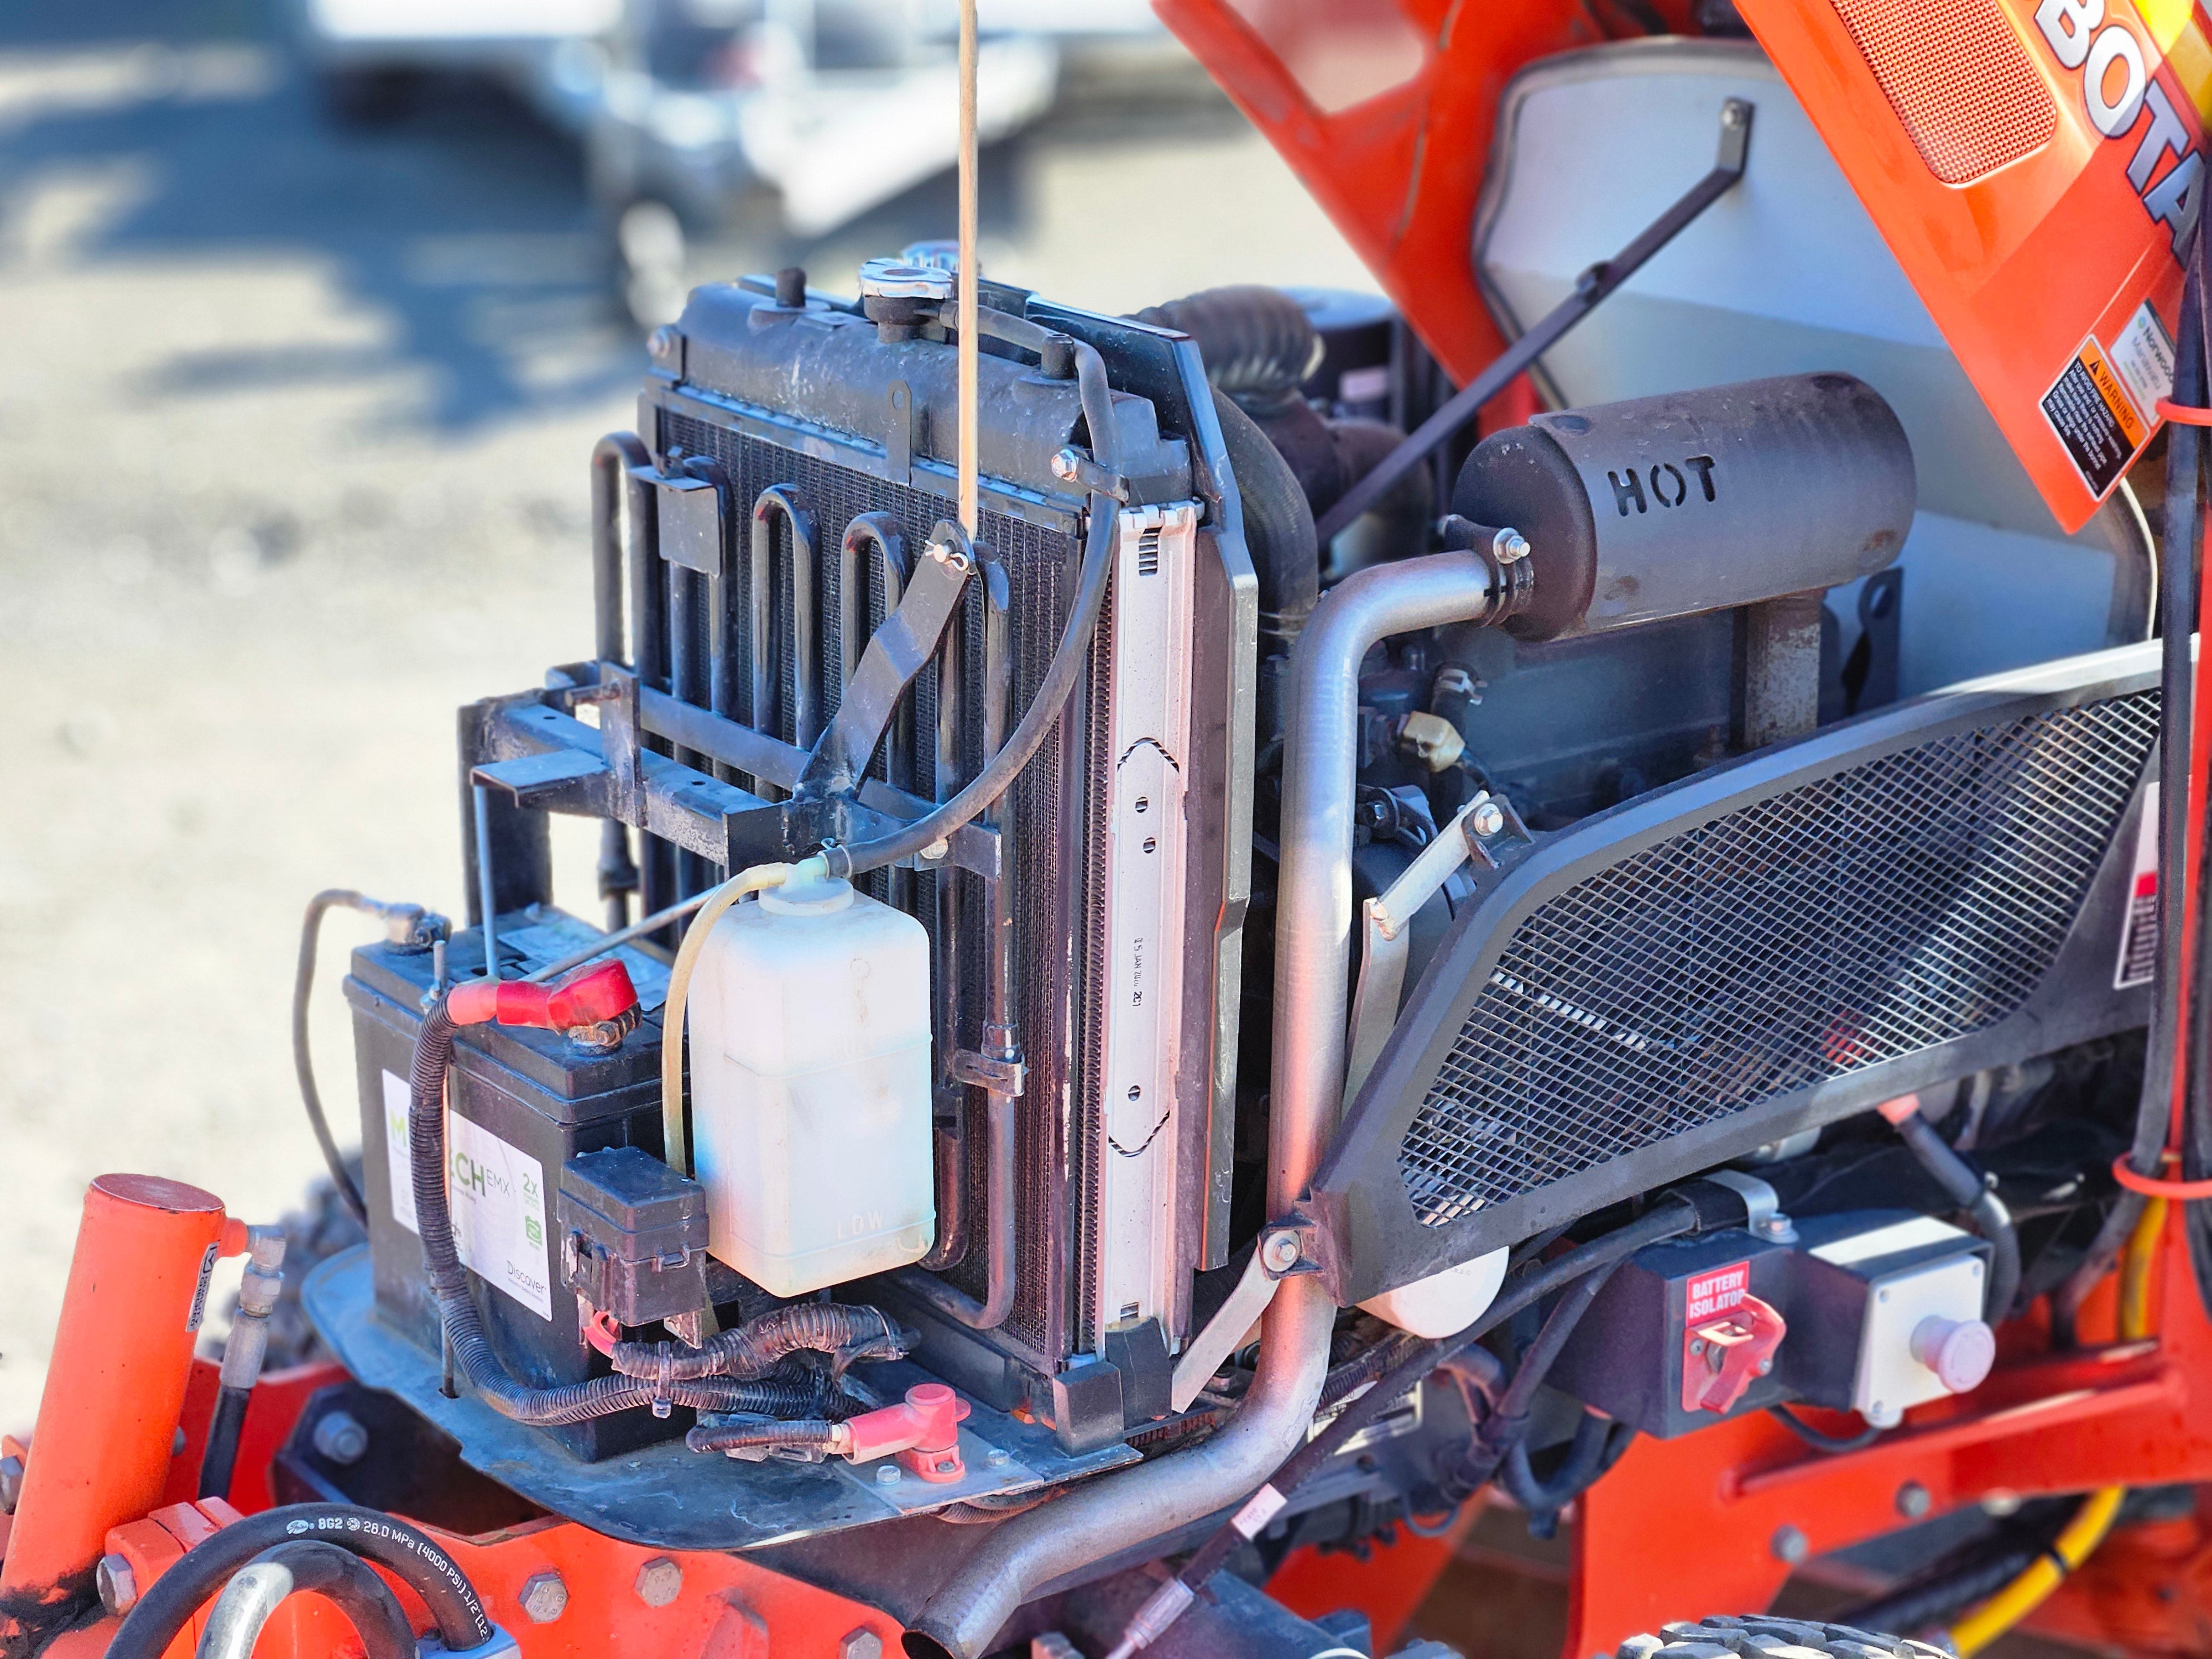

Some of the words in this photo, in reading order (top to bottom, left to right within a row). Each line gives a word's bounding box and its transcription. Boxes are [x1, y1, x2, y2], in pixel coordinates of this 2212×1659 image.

[2069, 368, 2079, 384] After
[2074, 361, 2082, 373] TO
[2079, 369, 2093, 391] AVOID
[2090, 388, 2101, 405] FIRE
[2099, 372, 2133, 429] WARNING
[1608, 453, 1715, 517] HOT
[487, 1168, 510, 1198] EMX
[835, 1210, 883, 1240] LOW
[507, 1260, 544, 1295] Discover
[1693, 1271, 1744, 1300] BATTERY
[363, 1521, 390, 1537] 28.0
[390, 1531, 415, 1549] MPa
[417, 1541, 448, 1572] (4000
[446, 1567, 467, 1594] PSI)
